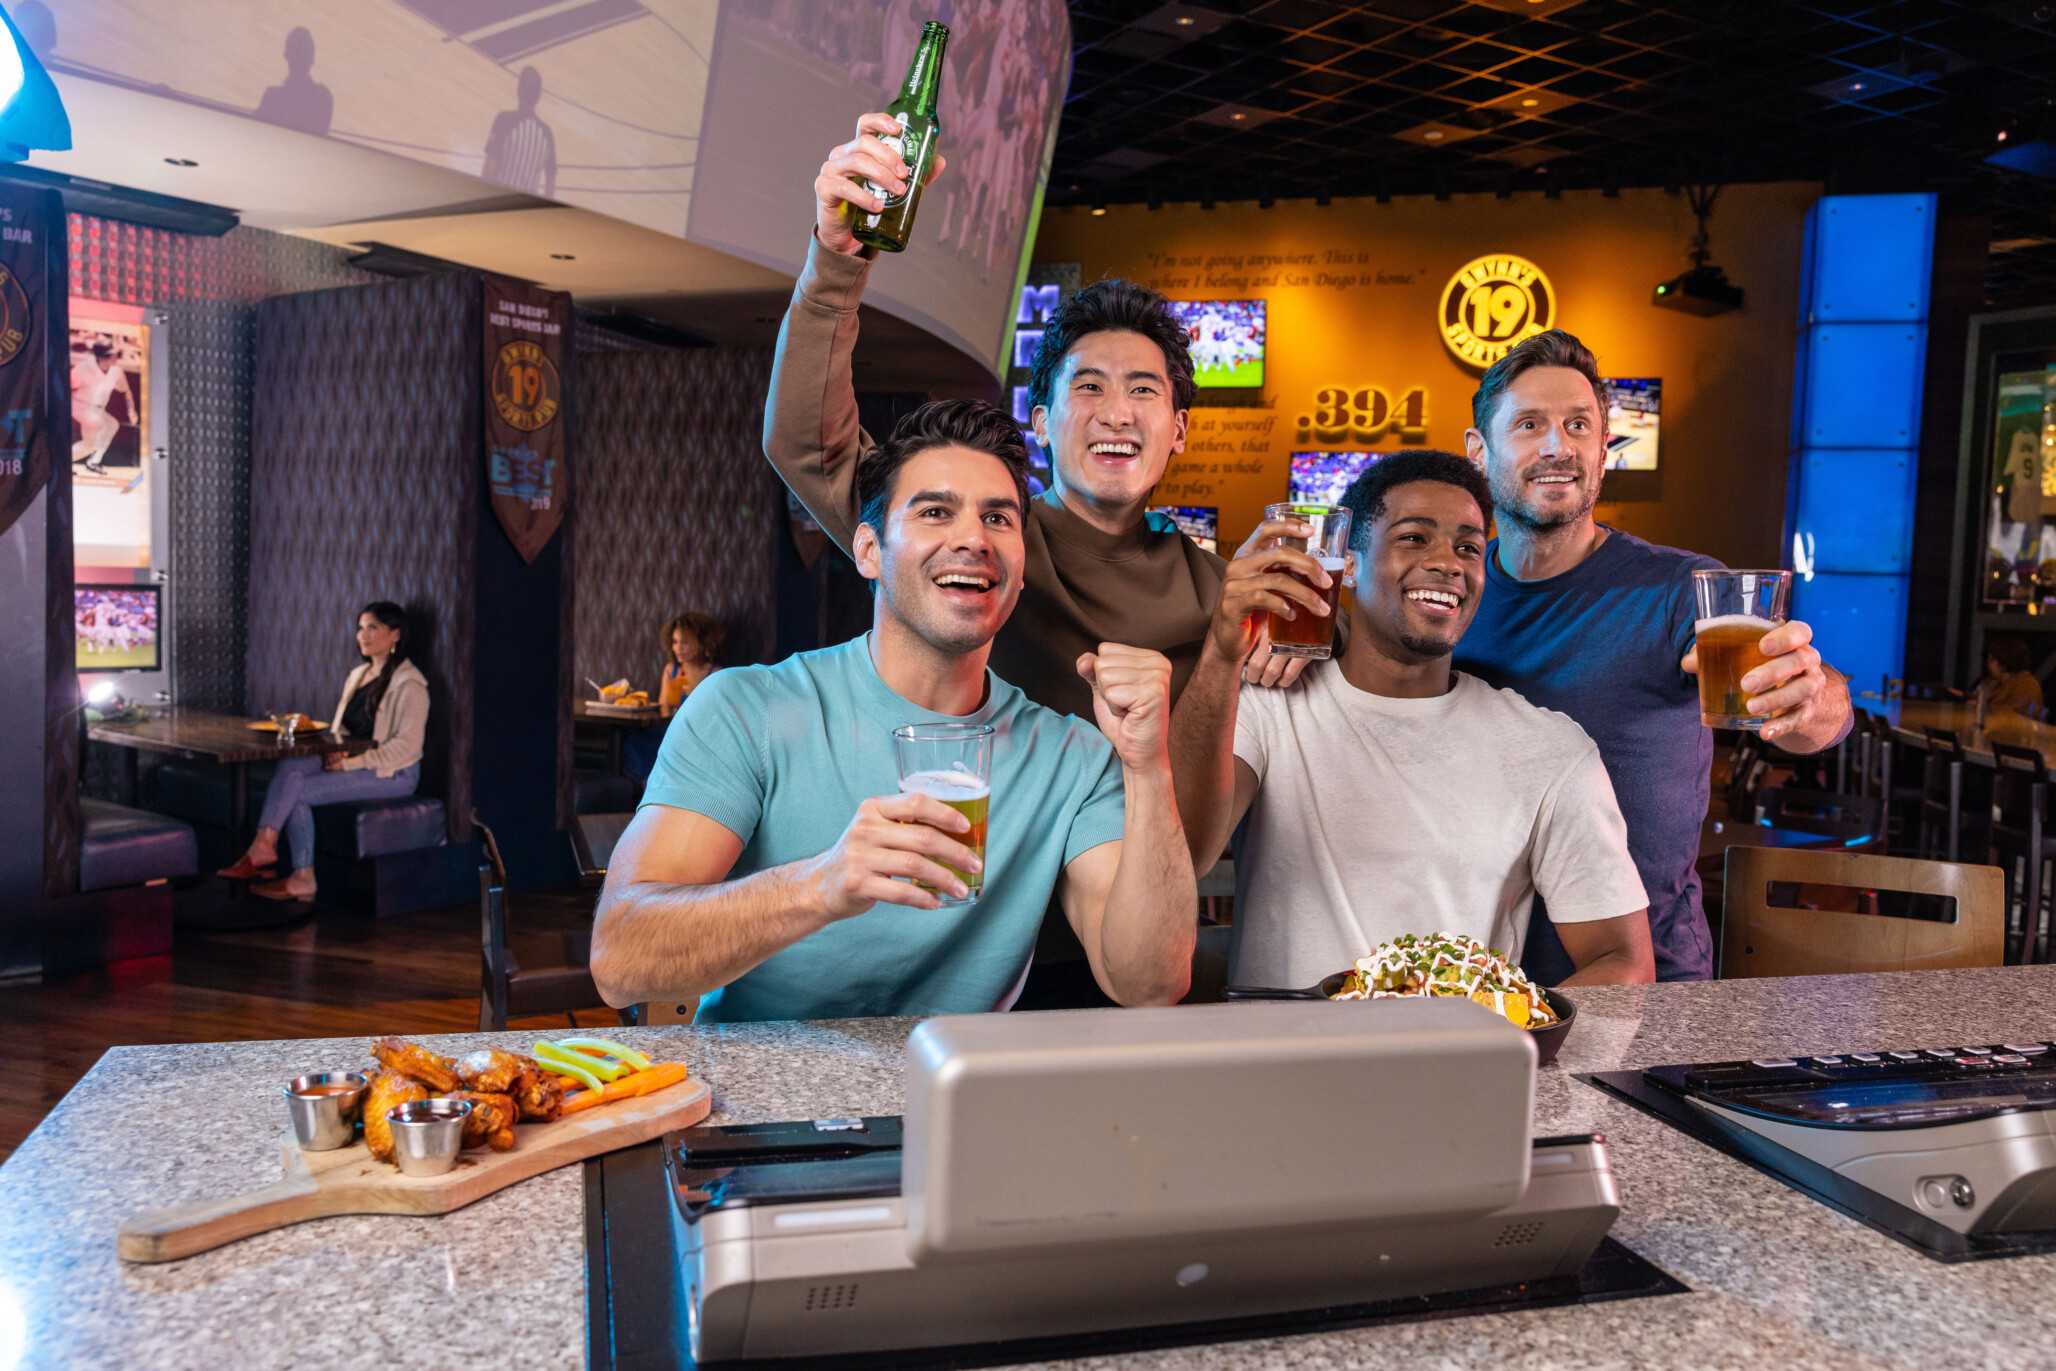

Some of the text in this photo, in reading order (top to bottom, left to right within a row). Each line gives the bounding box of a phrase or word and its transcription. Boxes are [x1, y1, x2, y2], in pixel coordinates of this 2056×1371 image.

[2, 227, 32, 245] BAR
[1204, 256, 1244, 271] going
[1324, 249, 1354, 264] This
[1205, 272, 1248, 292] belong
[1251, 271, 1280, 287] and
[1285, 272, 1310, 287] San
[1316, 272, 1357, 291] Diego
[1470, 284, 1527, 337] 19
[509, 366, 538, 404] 19
[1297, 388, 1427, 428] .394
[1219, 415, 1279, 436] yourself
[1192, 437, 1236, 454] others,
[1241, 436, 1272, 453] that
[1223, 458, 1264, 474] whole
